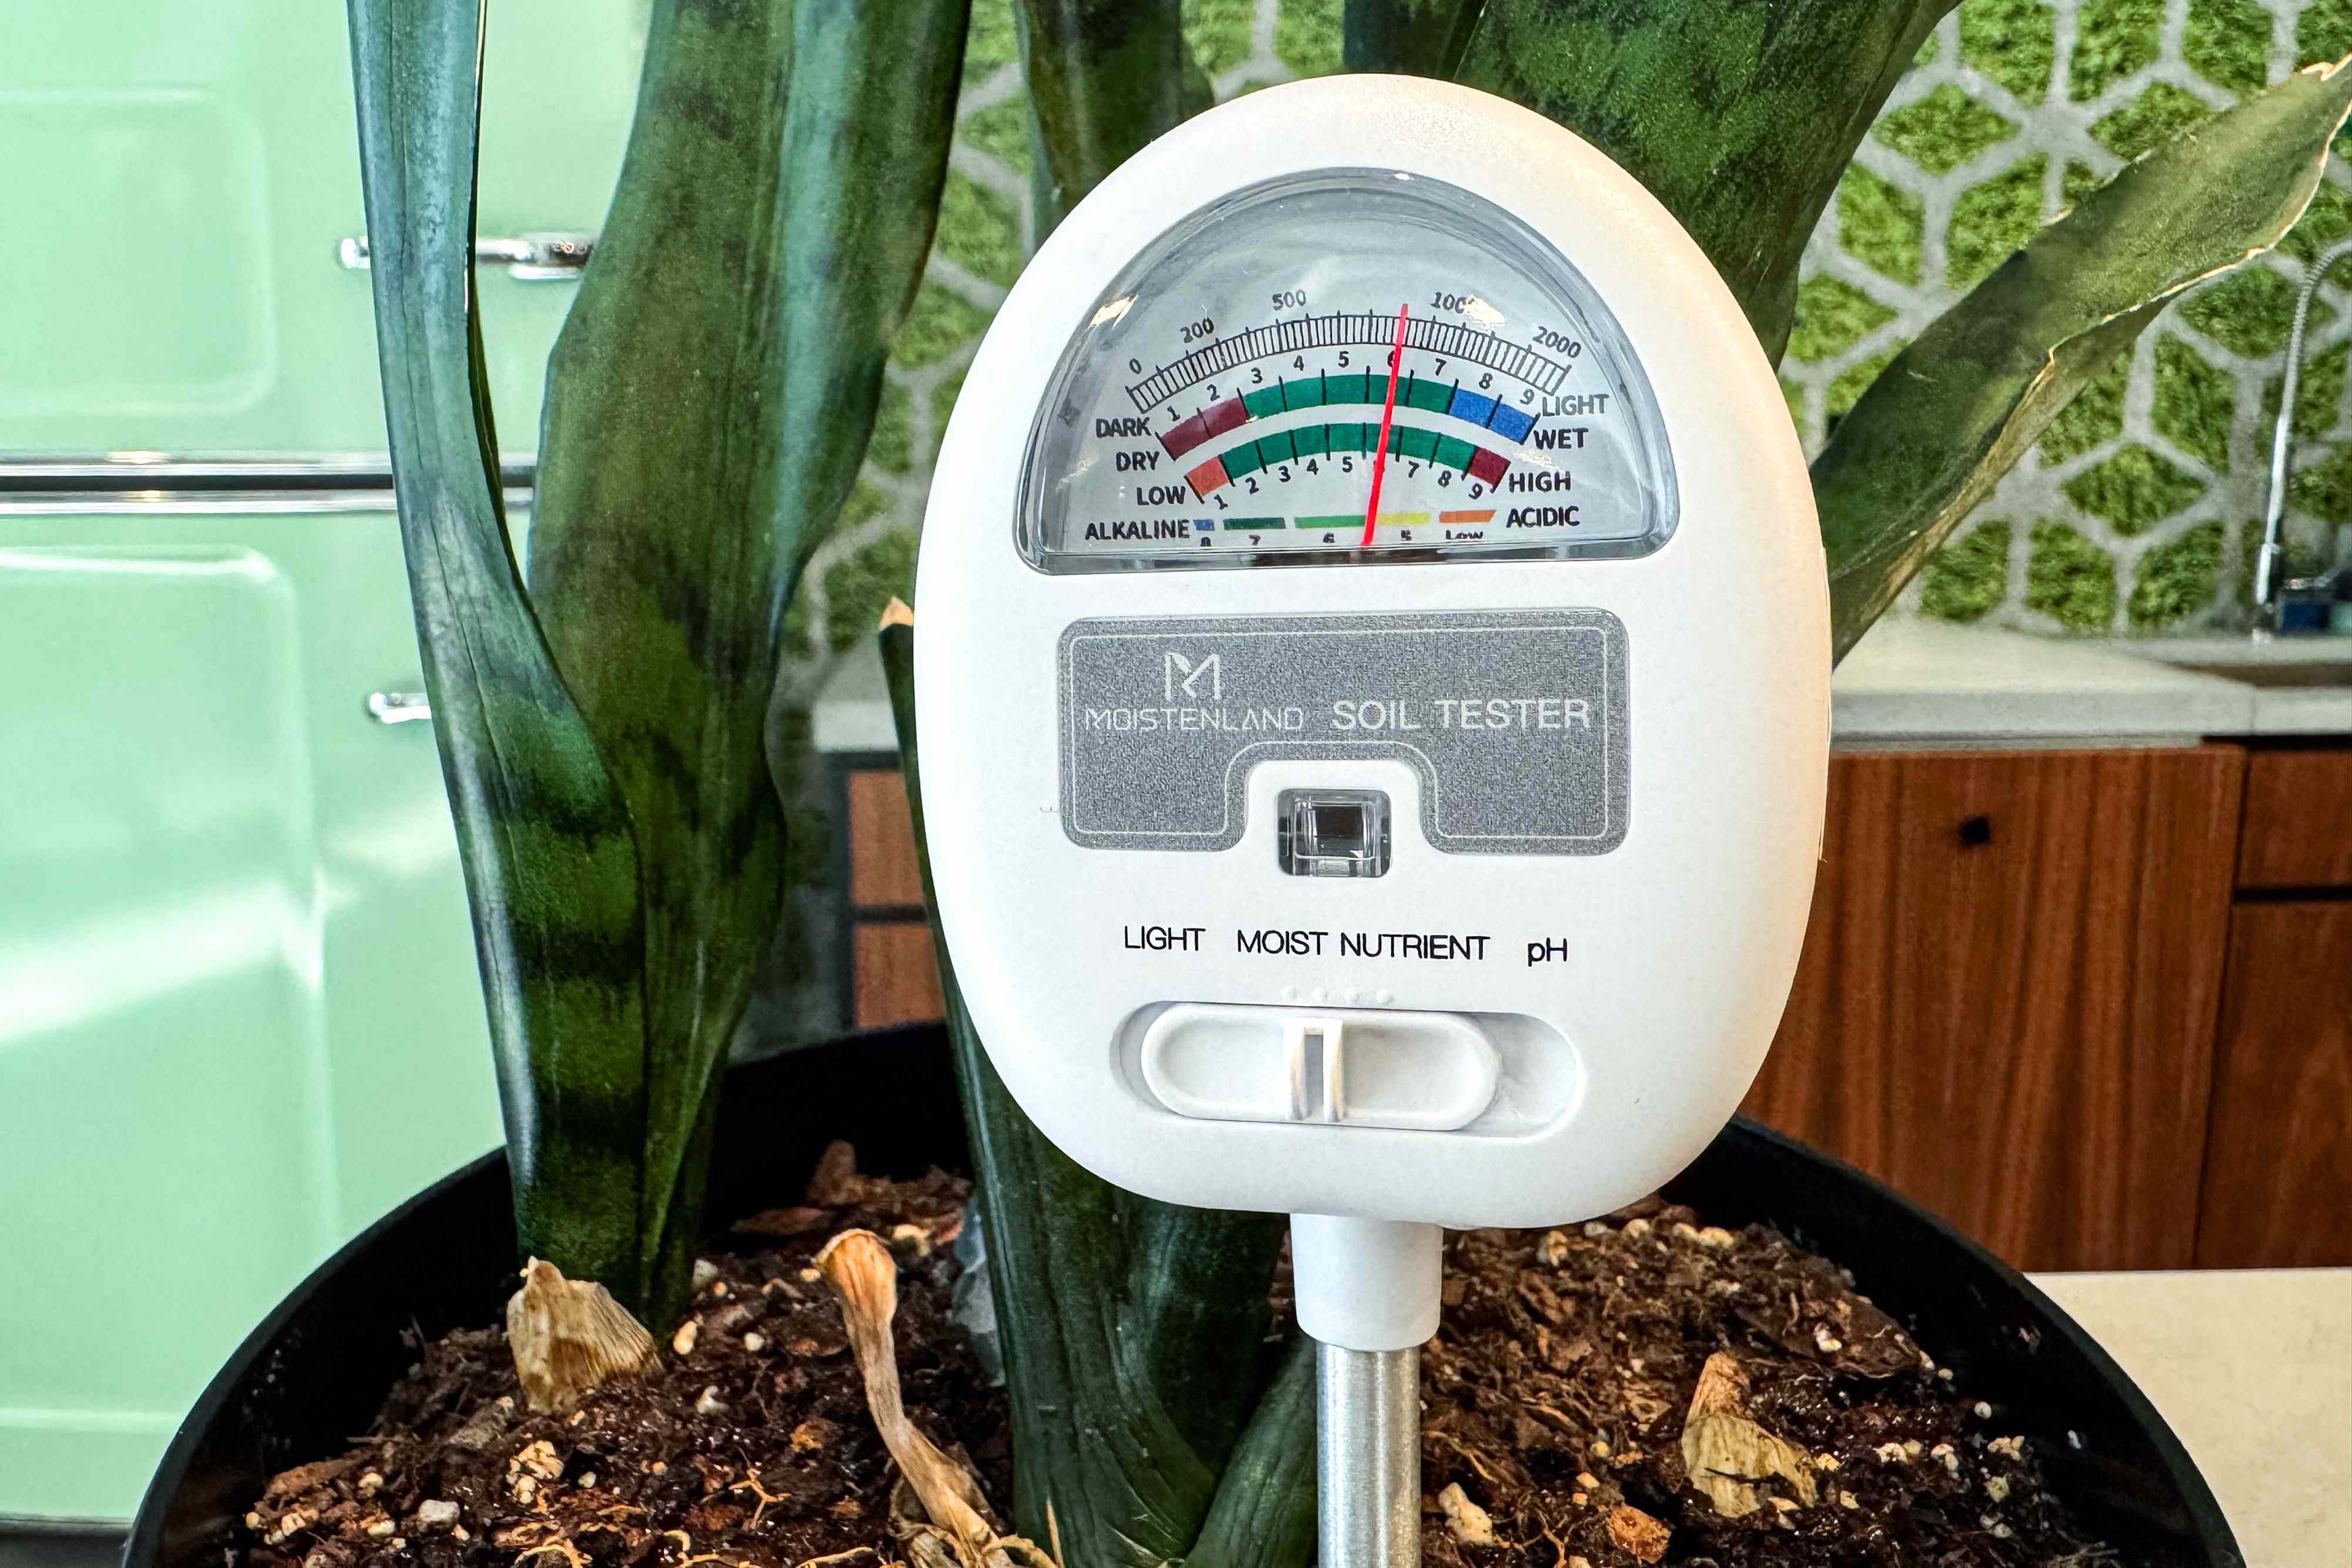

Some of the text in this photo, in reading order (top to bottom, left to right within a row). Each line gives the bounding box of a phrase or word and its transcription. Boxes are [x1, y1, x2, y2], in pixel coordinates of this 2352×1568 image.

[1129, 289, 1581, 375] 0 200 500 100 2000
[1167, 406, 1180, 421] 1
[1207, 385, 1220, 400] 2
[1251, 367, 1263, 383] 3
[1294, 356, 1304, 371] 4
[1339, 351, 1349, 367] 5
[1435, 358, 1447, 376] 7
[1479, 373, 1492, 389] 8
[1519, 389, 1534, 404] 9
[1542, 393, 1609, 417] LIGHT
[1095, 417, 1151, 438] DARK
[1534, 428, 1588, 450] WET
[1116, 452, 1160, 472] DRY
[1214, 457, 1483, 510] 1 2 3 4 5 7 8 9
[1508, 472, 1571, 493] HIGH
[1137, 486, 1185, 505] LOW
[1506, 506, 1580, 528] ACIDIC
[1085, 519, 1190, 540] ALKALINE
[1085, 707, 1304, 731] MOISTENLAND
[1331, 698, 1591, 731] SOIL TESTER
[1124, 925, 1568, 966] LIGHT MOIST NUTRIENT pH
